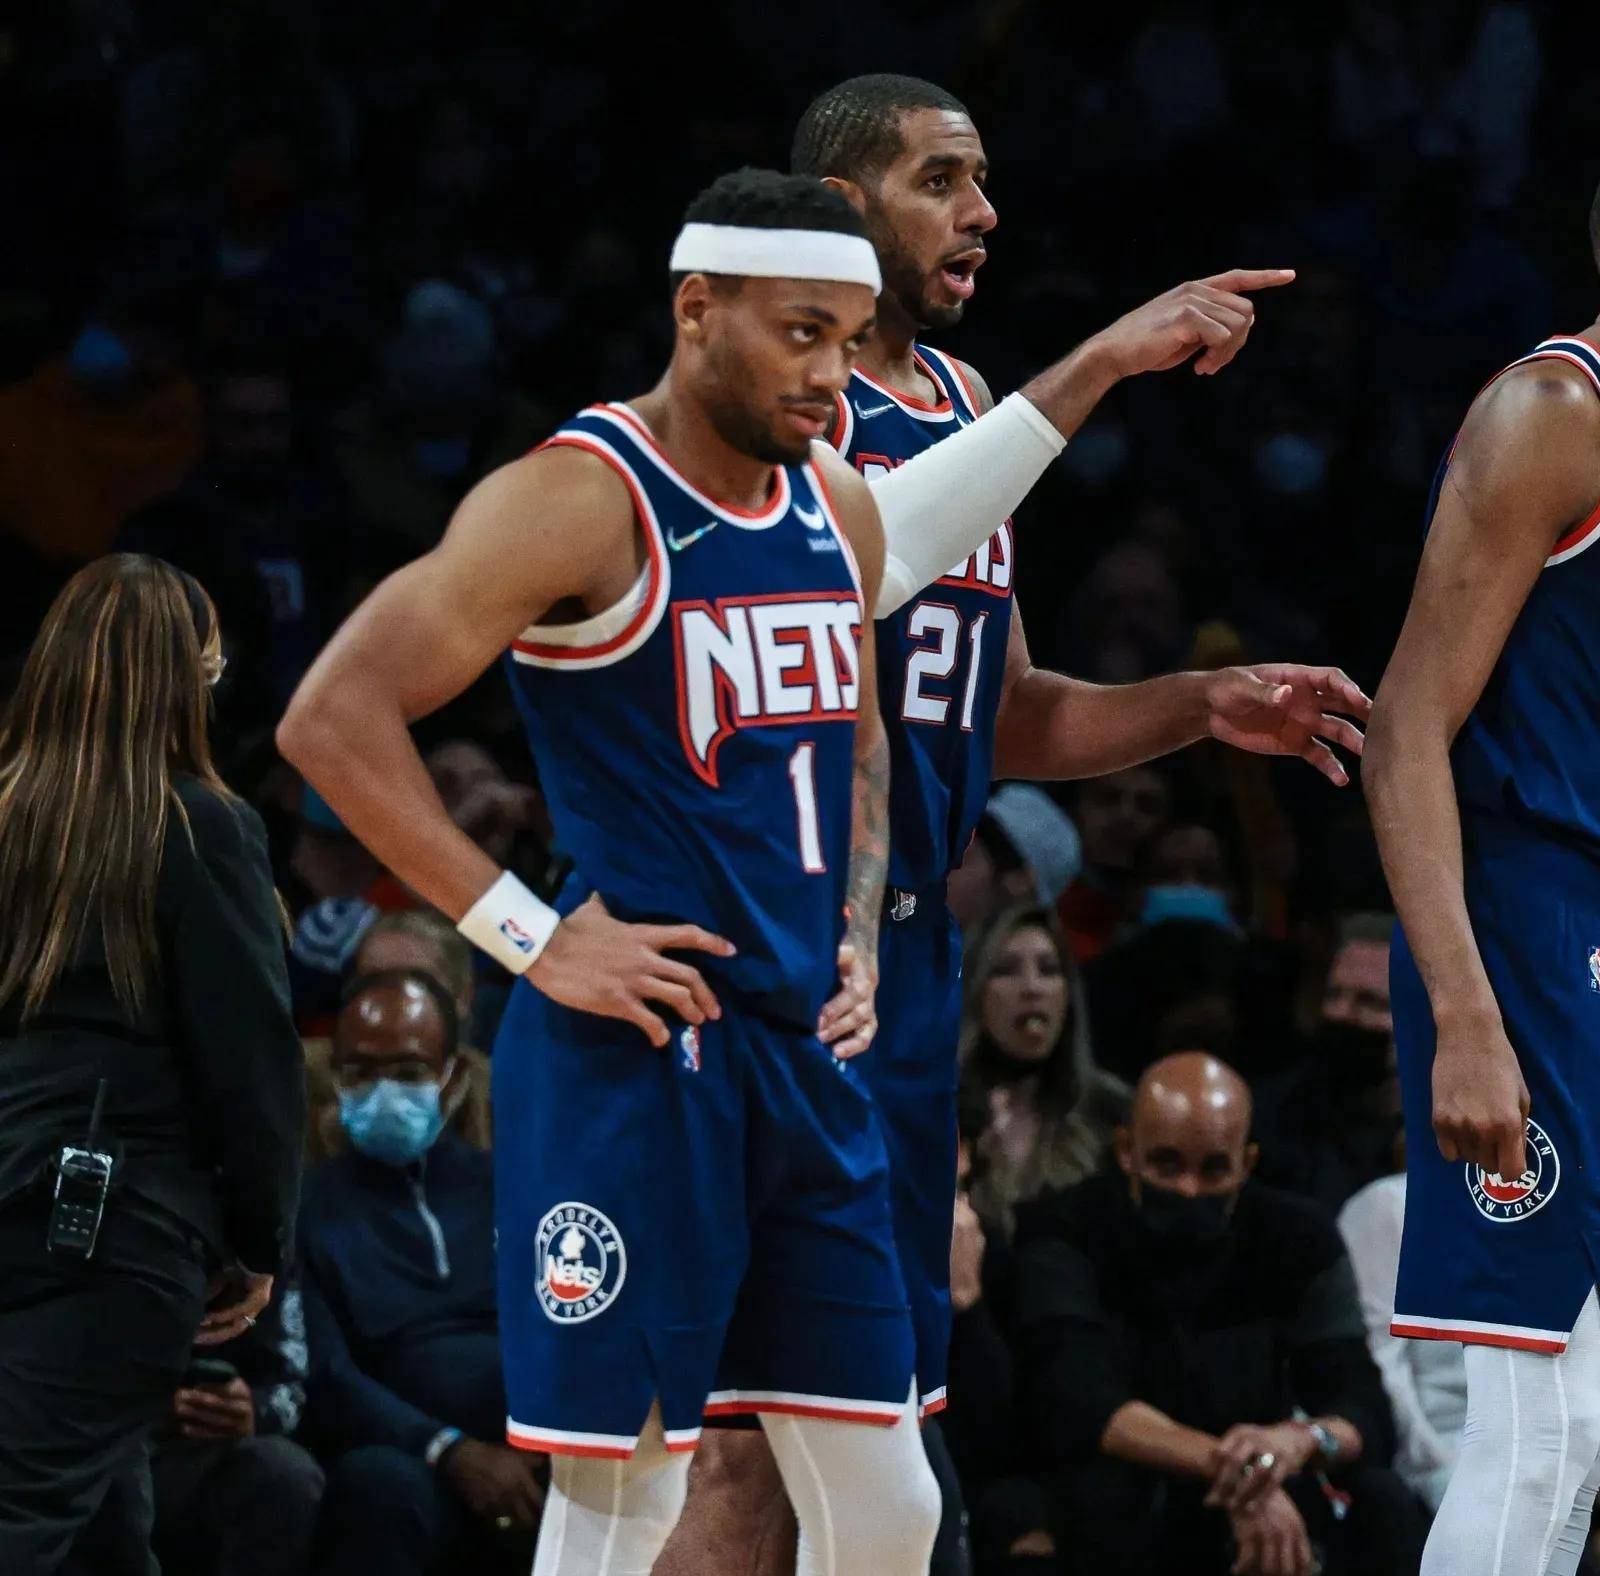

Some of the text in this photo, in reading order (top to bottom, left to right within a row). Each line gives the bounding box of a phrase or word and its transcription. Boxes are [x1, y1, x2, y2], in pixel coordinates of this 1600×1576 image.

[900, 601, 989, 731] 21
[789, 741, 826, 874] 1
[1472, 1183, 1545, 1217] NEW YORK
[564, 1288, 609, 1317] YORK
